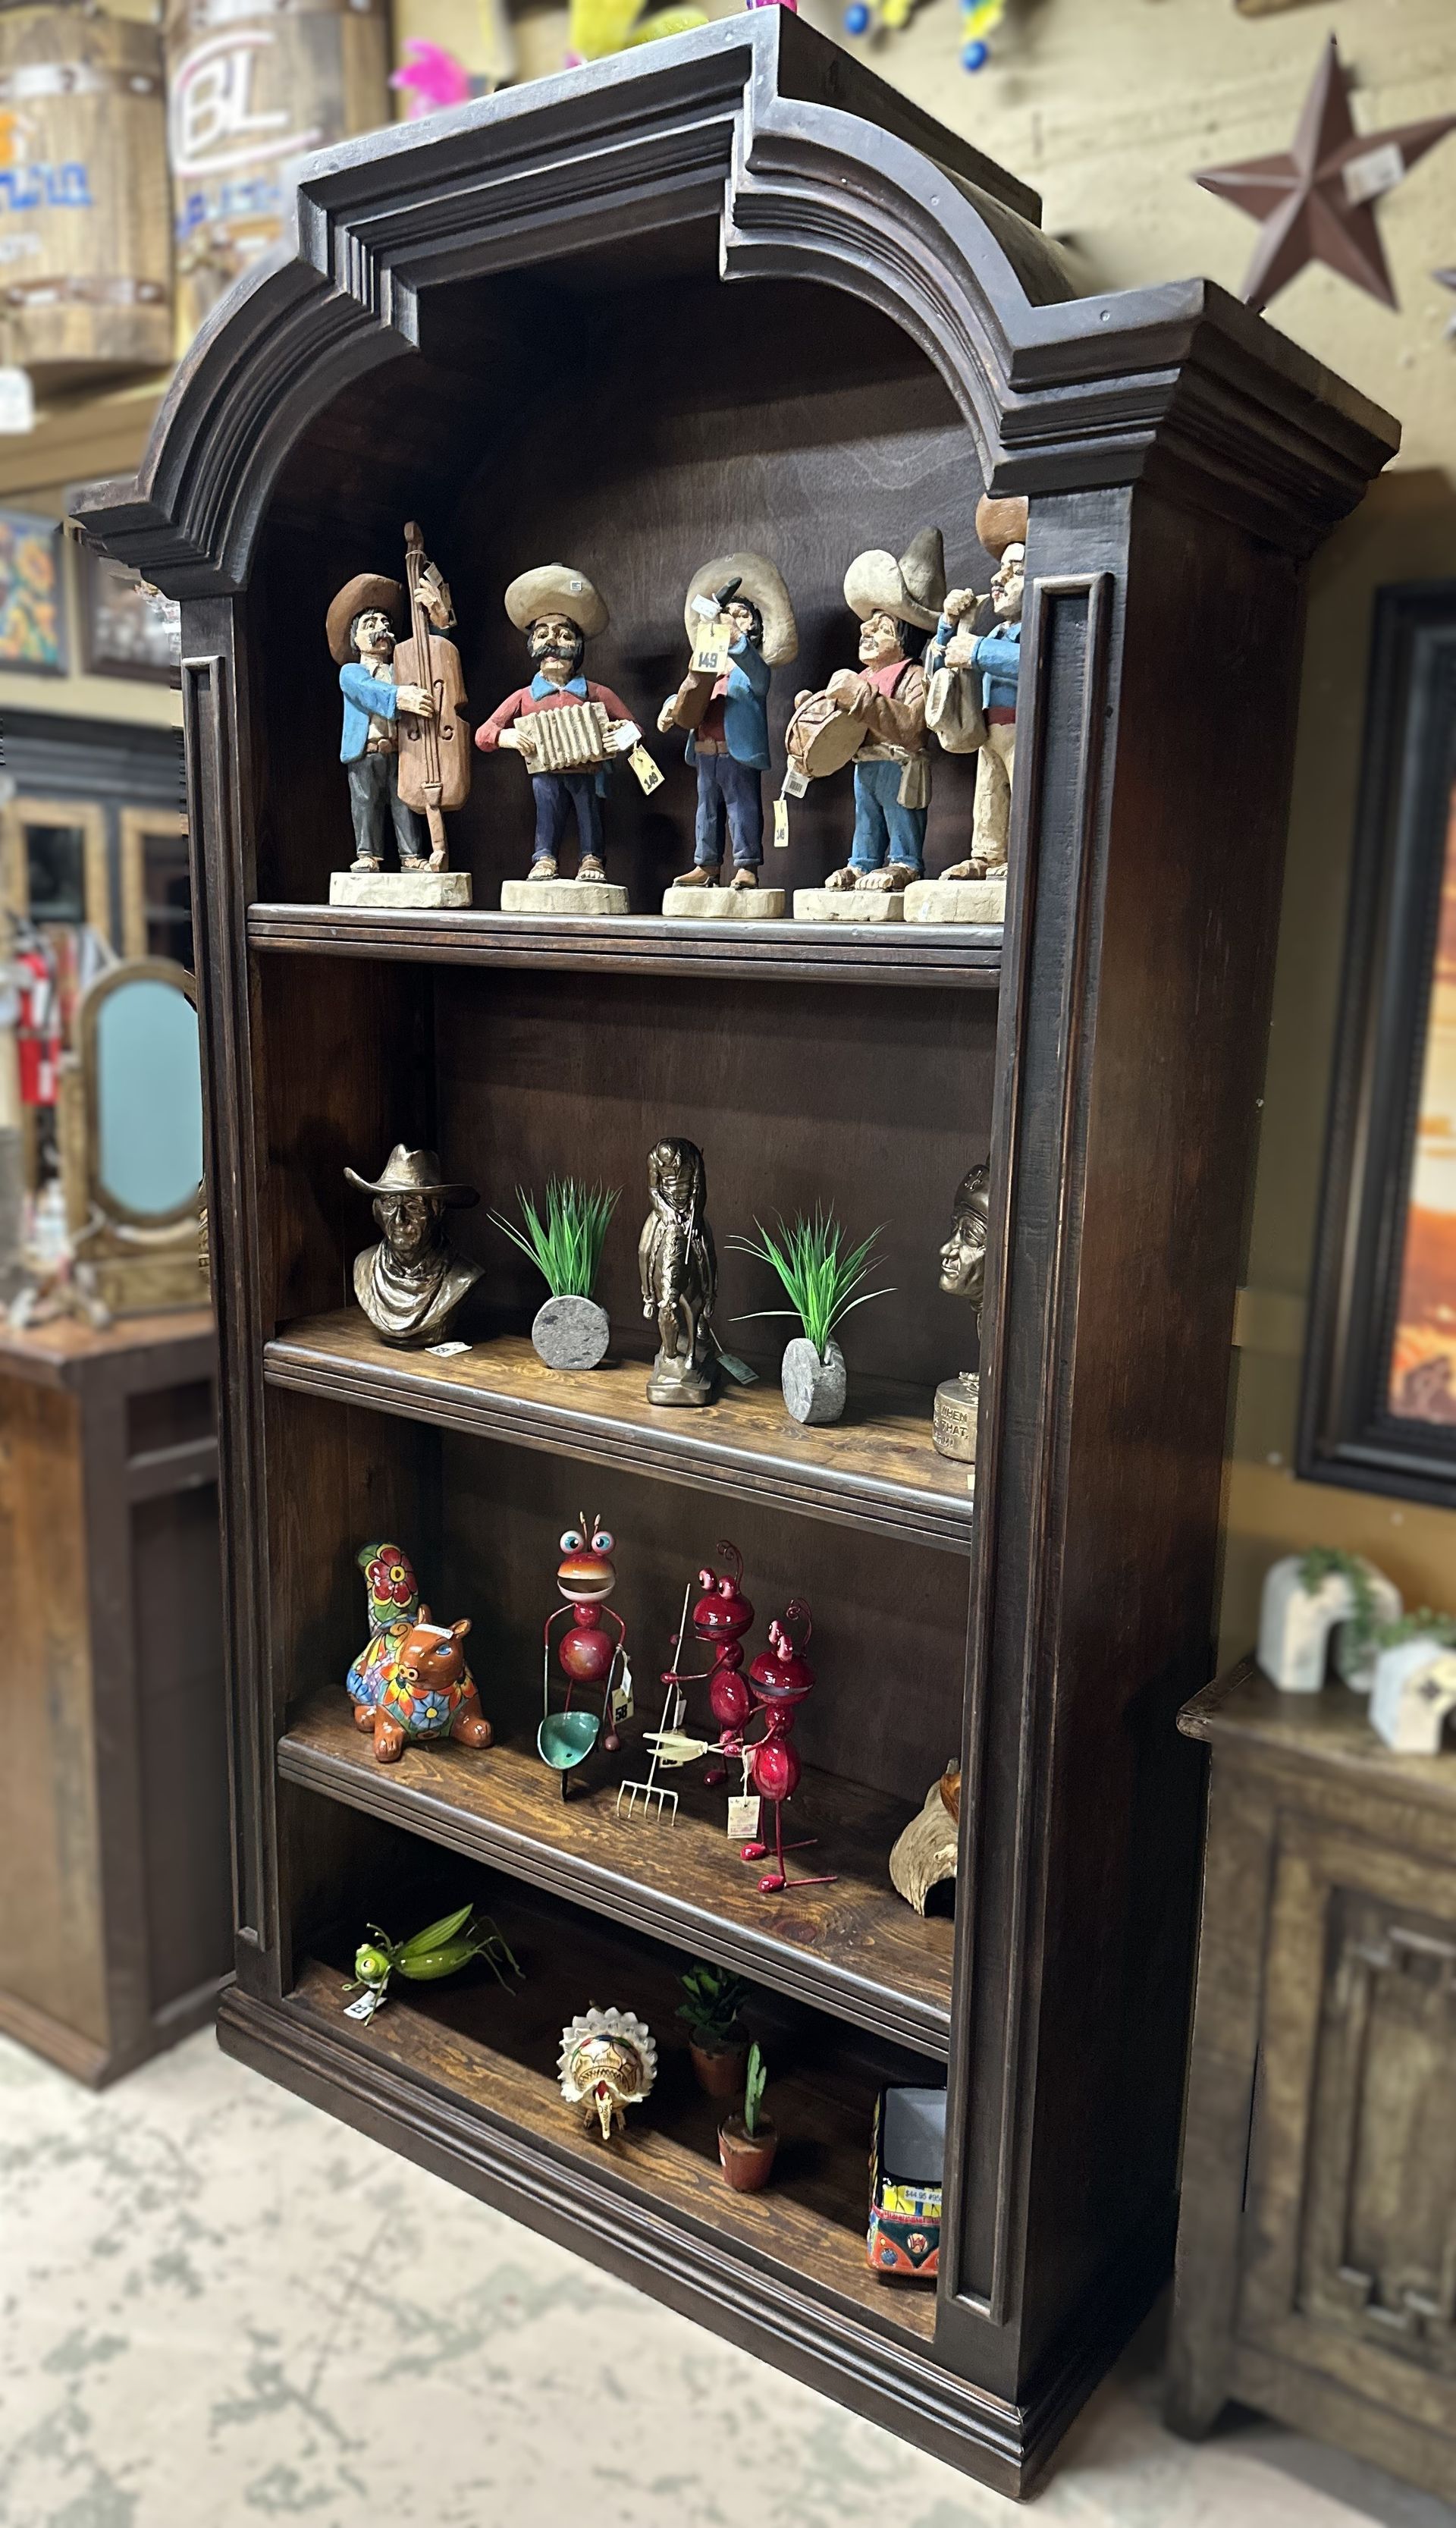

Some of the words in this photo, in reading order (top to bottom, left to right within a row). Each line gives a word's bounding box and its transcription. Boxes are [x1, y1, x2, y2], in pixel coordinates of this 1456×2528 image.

[182, 49, 289, 156] BL
[698, 652, 718, 668] 149
[644, 771, 658, 790] 149
[615, 1704, 628, 1721] 58
